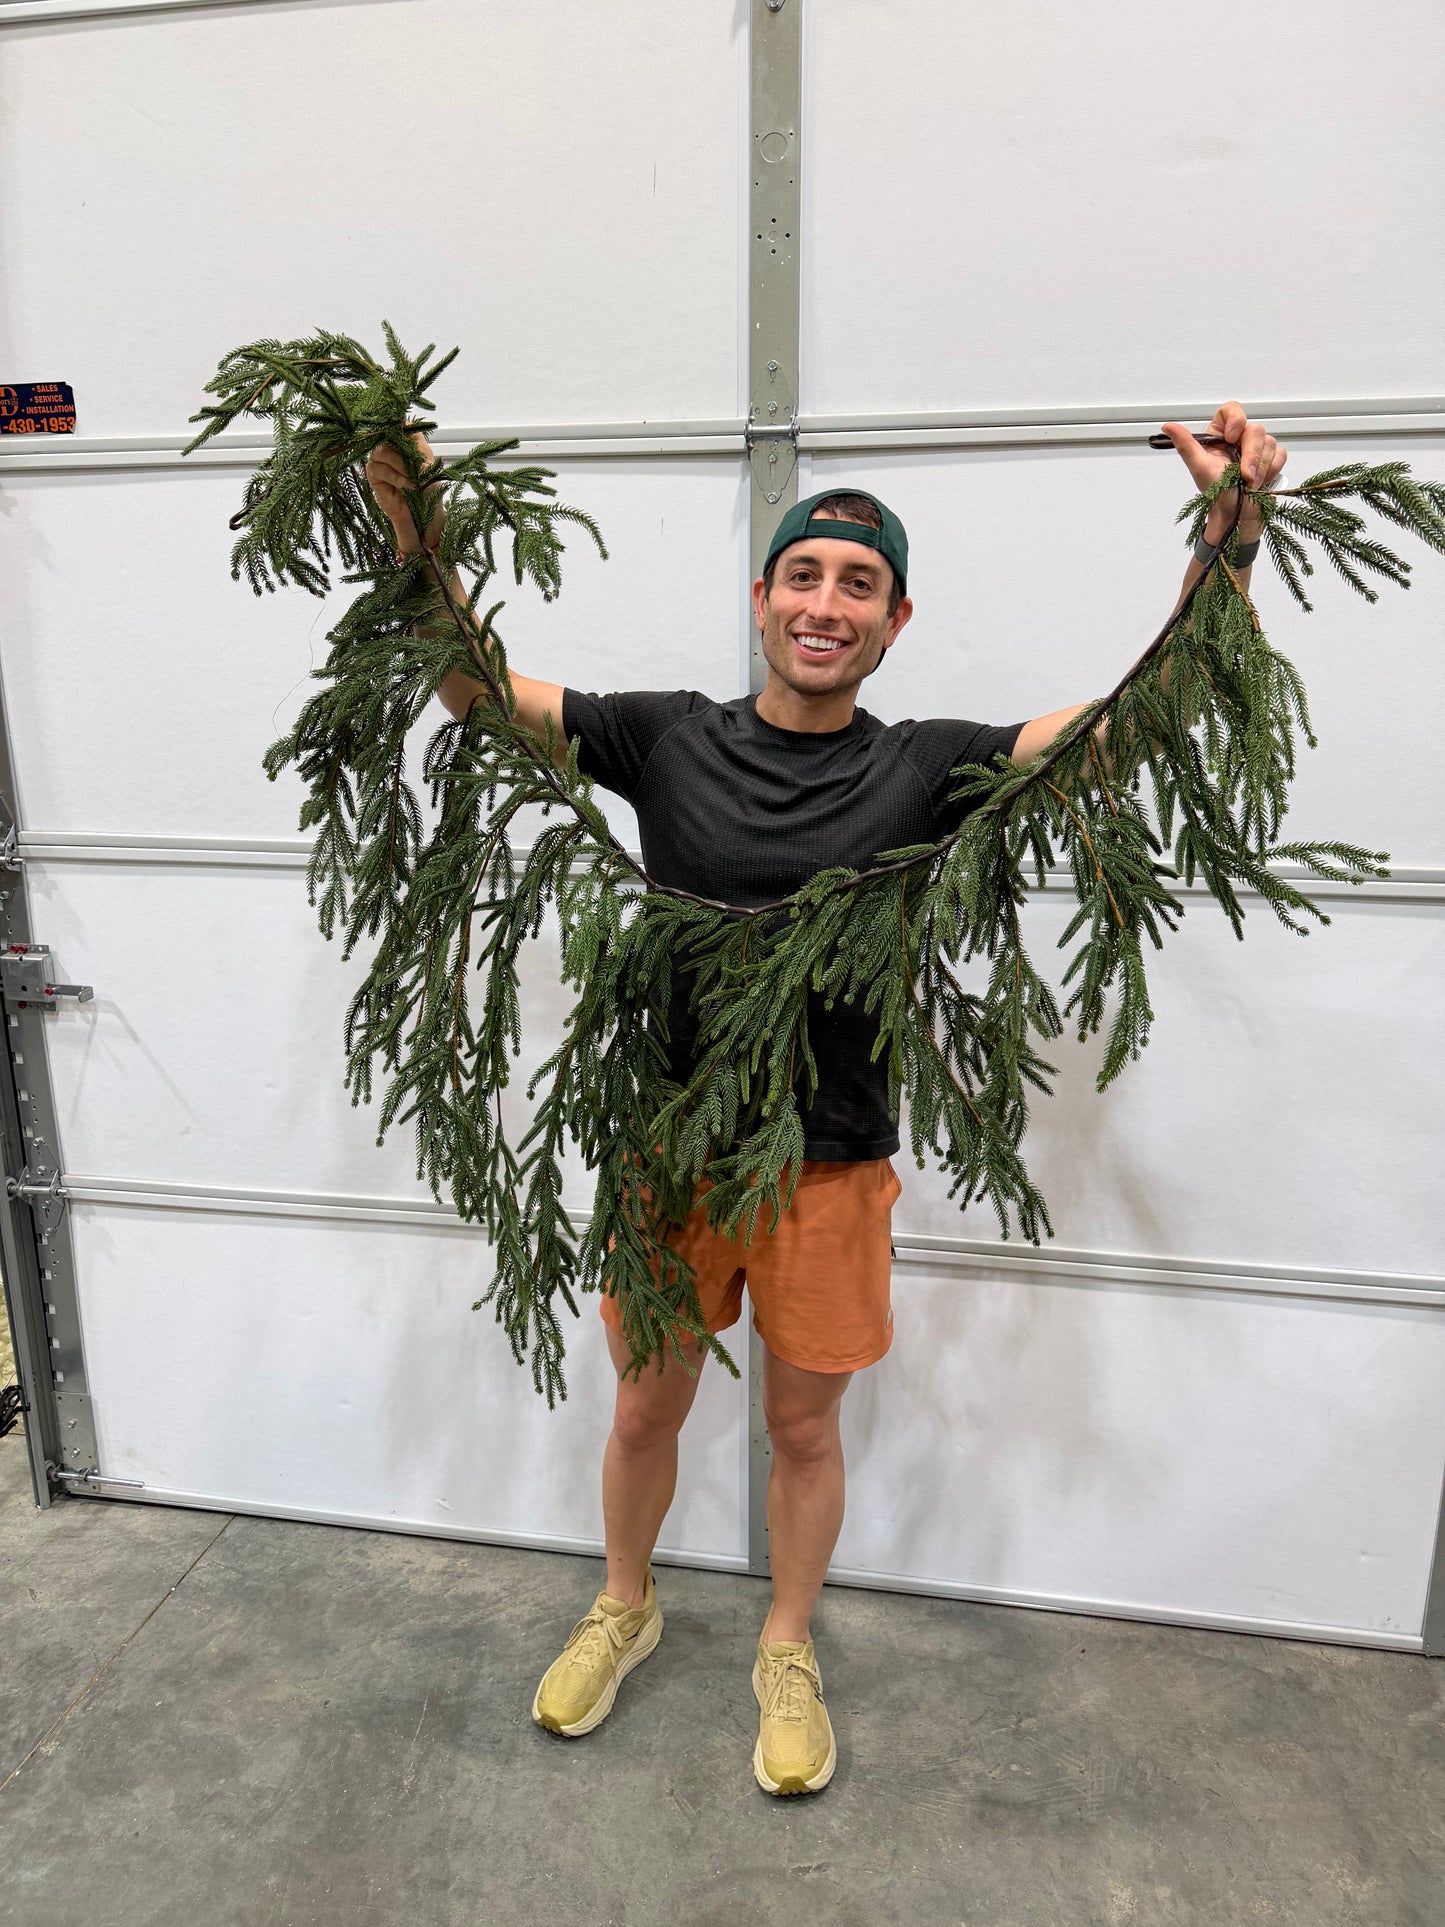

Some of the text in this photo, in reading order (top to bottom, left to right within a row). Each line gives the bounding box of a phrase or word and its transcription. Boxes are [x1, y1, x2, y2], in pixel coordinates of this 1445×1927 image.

[36, 384, 58, 393] SALES
[34, 394, 63, 404] SERVICE
[26, 404, 74, 414] INSTALLATION
